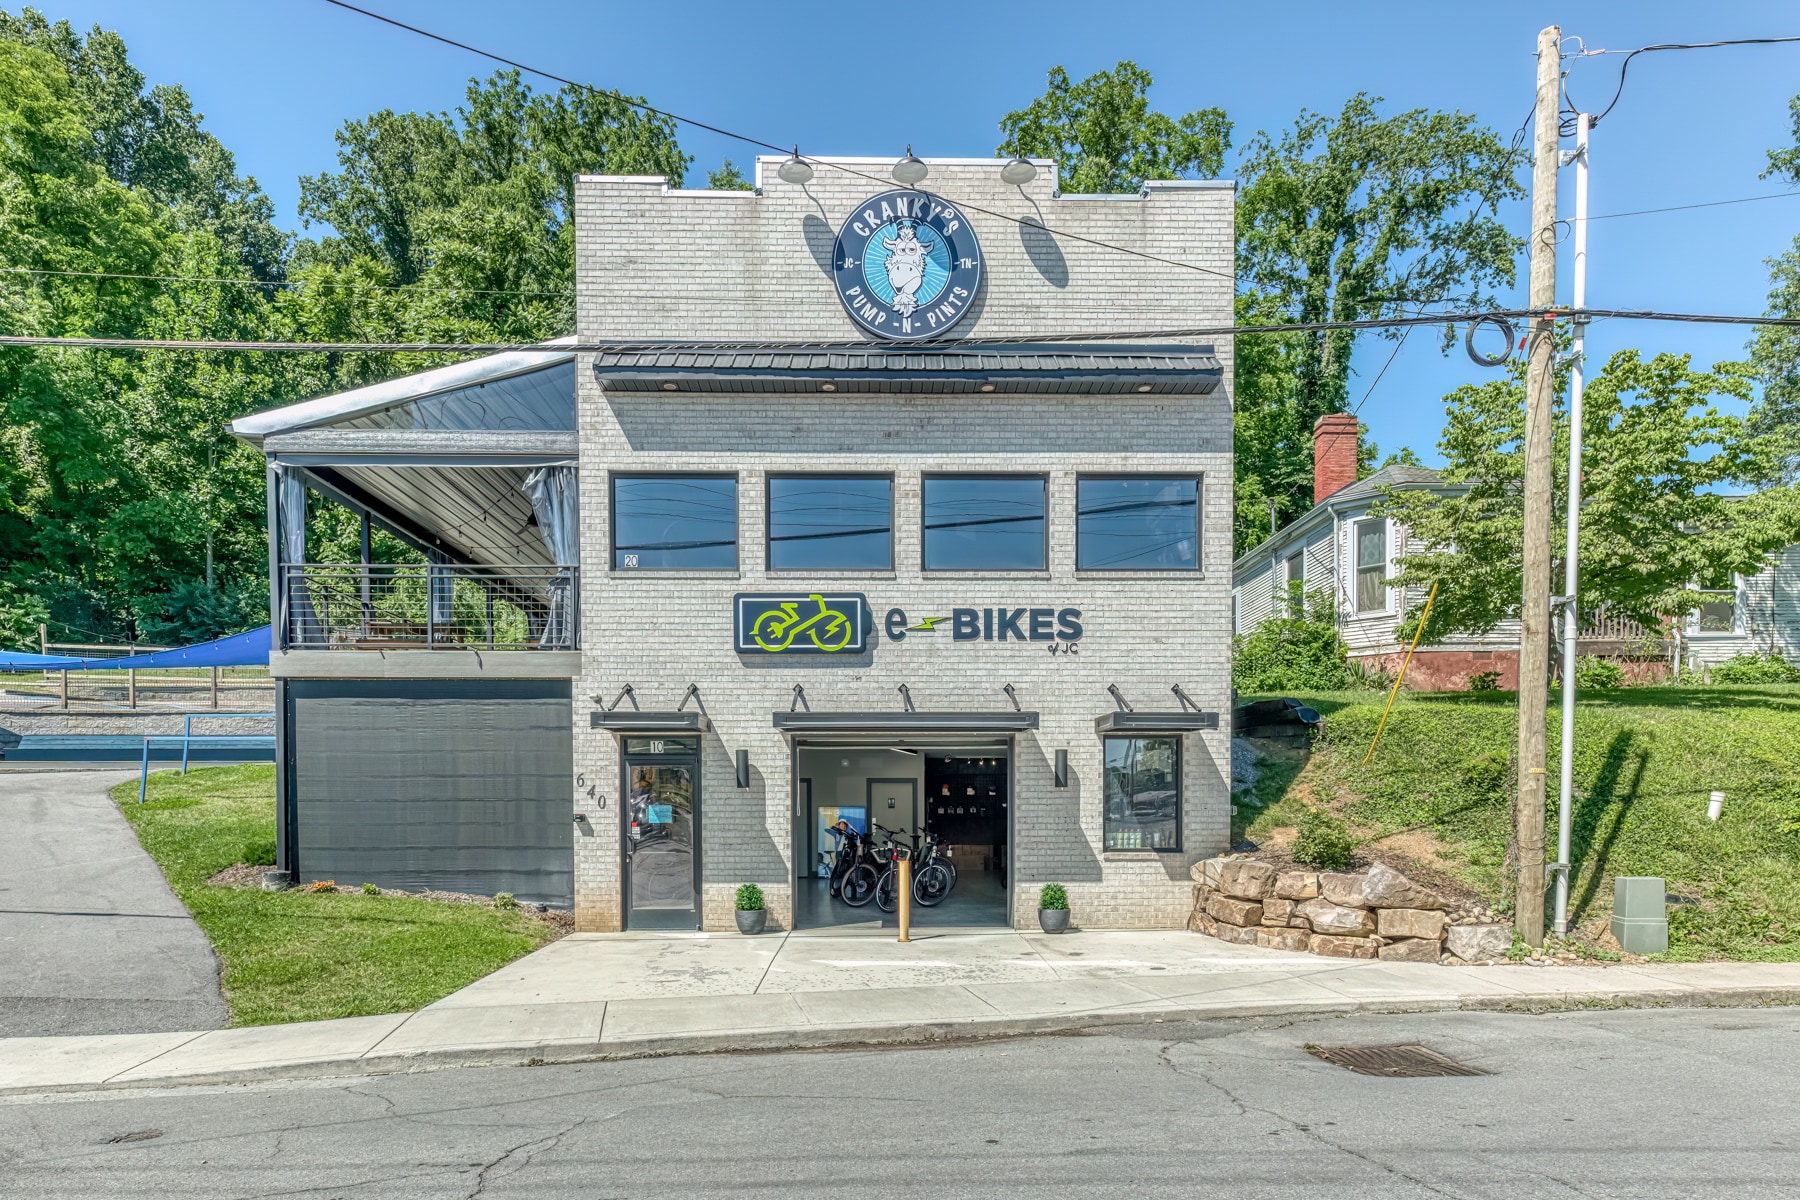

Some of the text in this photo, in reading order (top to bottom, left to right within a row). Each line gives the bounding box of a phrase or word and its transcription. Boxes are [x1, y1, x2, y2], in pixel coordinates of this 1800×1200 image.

[846, 285, 886, 327] PUMP
[927, 286, 968, 328] PINTS
[625, 555, 638, 567] 20
[1062, 642, 1079, 655] JC
[652, 741, 664, 753] 10
